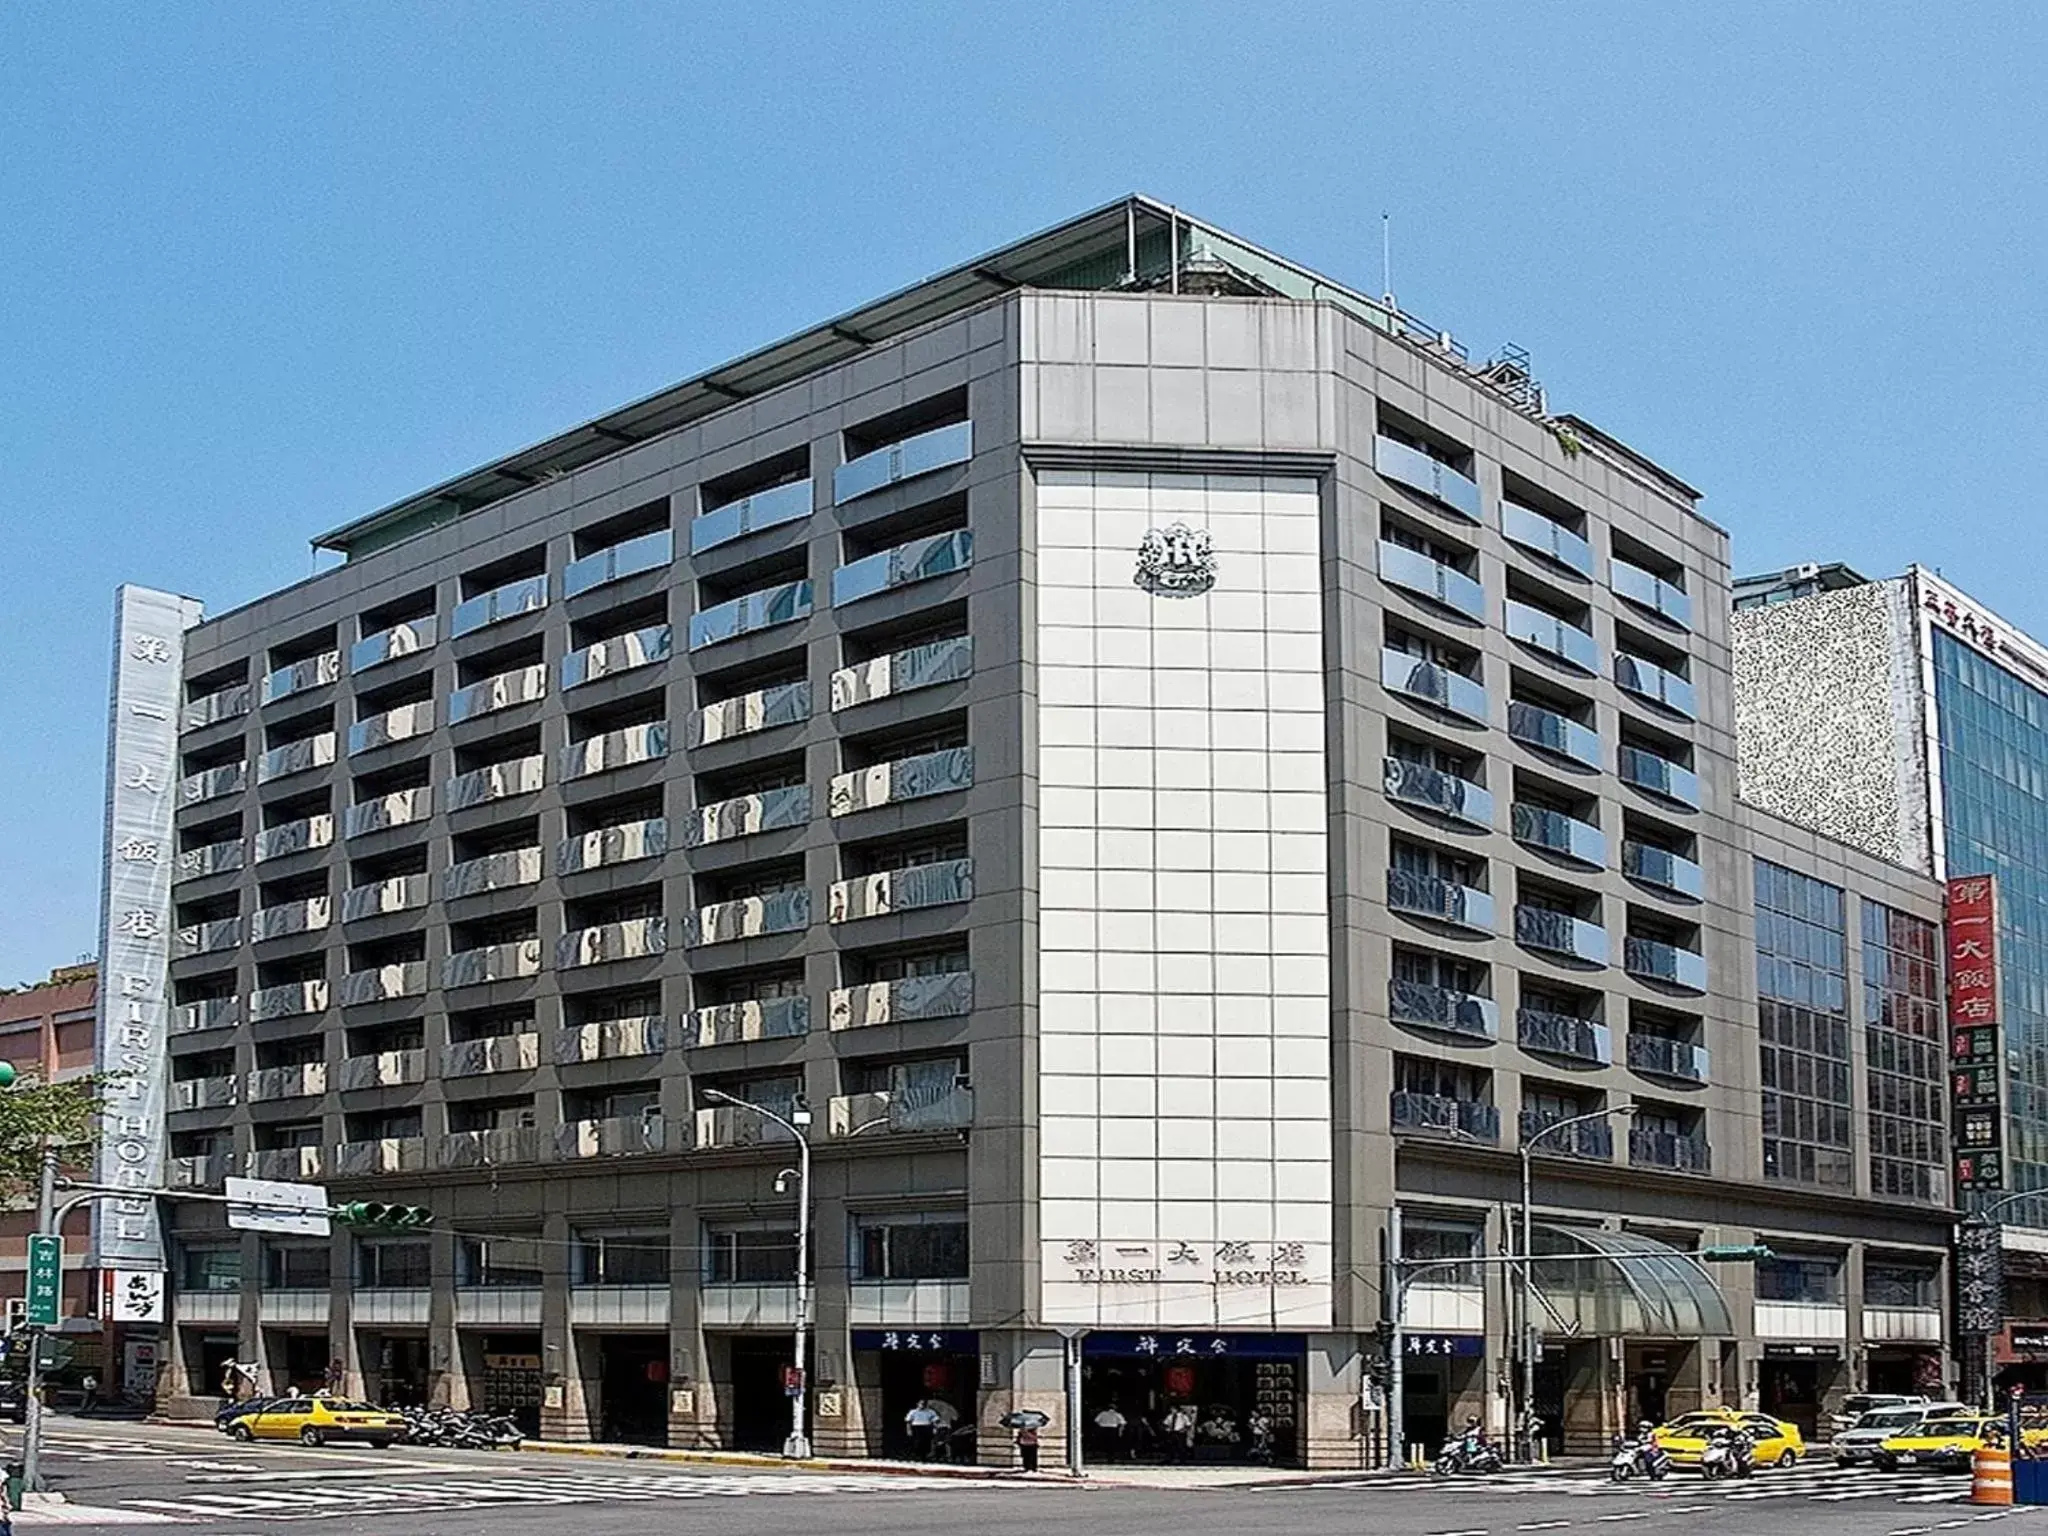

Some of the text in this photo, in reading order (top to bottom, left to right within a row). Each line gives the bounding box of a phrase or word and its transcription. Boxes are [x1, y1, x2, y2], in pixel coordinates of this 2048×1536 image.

[117, 632, 170, 939] 第一大飯店
[1952, 881, 1993, 1018] 第一大飯店
[117, 973, 151, 1242] FIRST HOTEL
[1063, 1239, 1306, 1266] 第一大飯店
[1075, 1268, 1309, 1286] FIRST HOTEL
